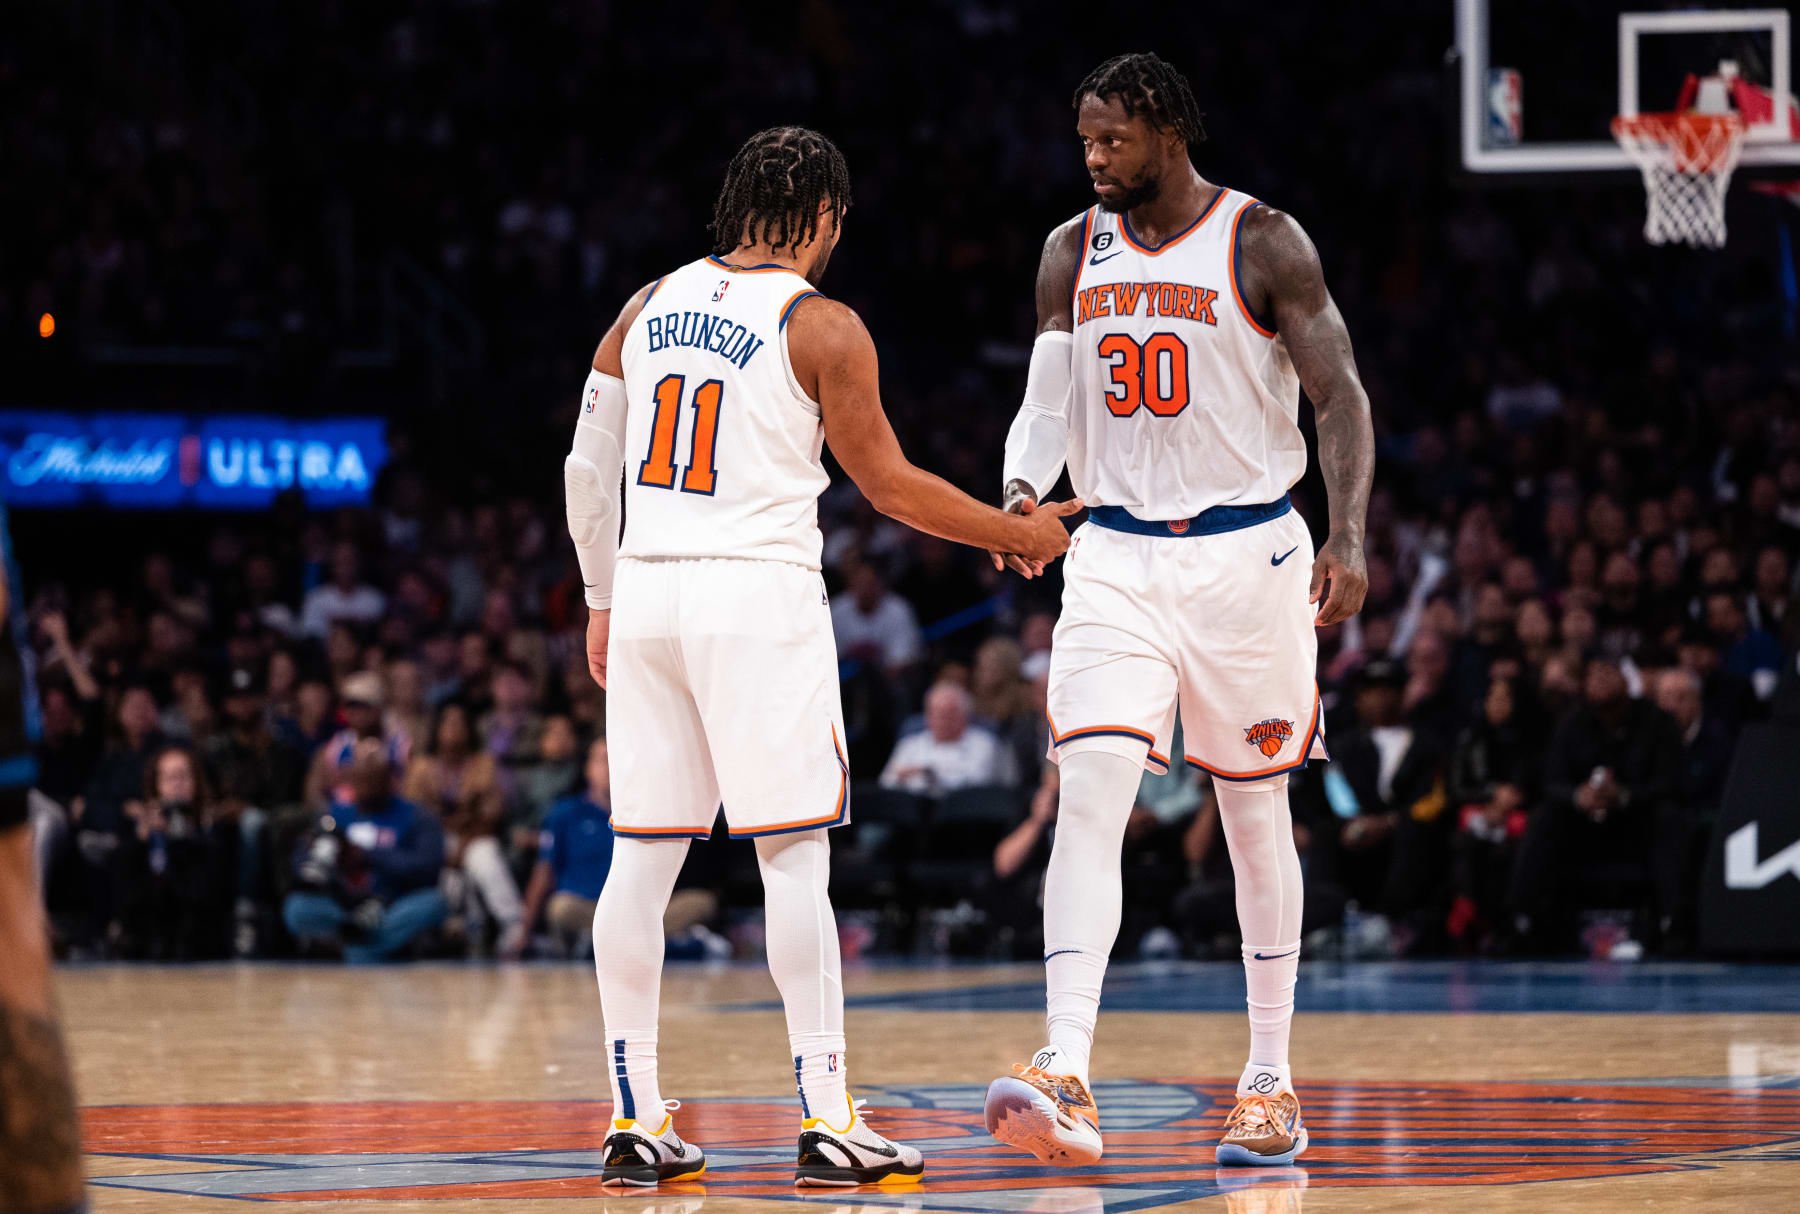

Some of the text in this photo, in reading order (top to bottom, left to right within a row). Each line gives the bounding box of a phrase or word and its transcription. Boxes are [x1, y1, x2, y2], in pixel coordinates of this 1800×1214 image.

[1096, 234, 1110, 249] 6
[1078, 282, 1218, 327] NEW YORK
[647, 311, 764, 369] BRUNSON
[1098, 332, 1190, 417] 30
[637, 373, 724, 497] 11
[208, 437, 369, 491] ULTRA
[1246, 719, 1293, 742] KNICKS
